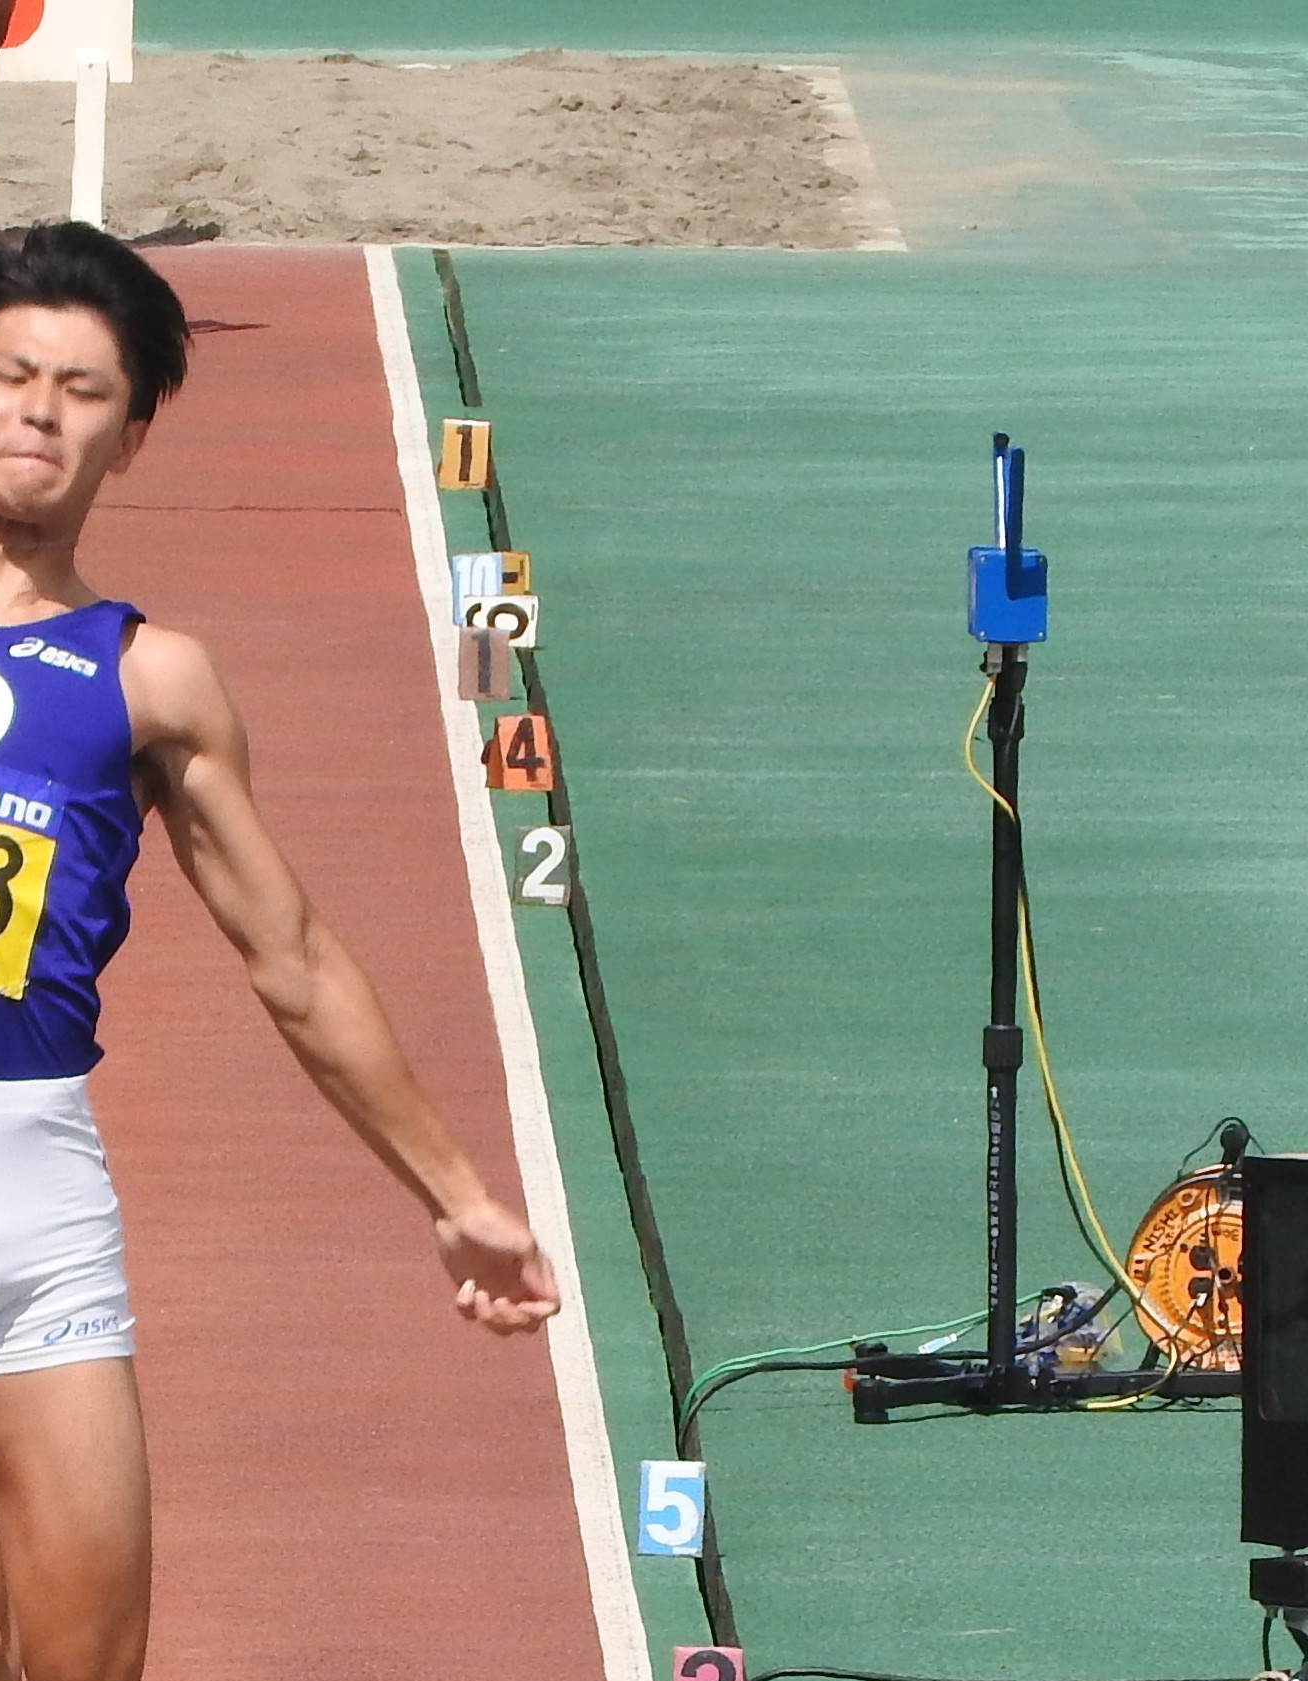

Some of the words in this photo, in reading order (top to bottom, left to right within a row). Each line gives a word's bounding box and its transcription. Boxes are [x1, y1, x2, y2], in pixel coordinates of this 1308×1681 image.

[455, 424, 473, 482] 1
[38, 645, 99, 678] asics
[472, 630, 491, 693] 1
[505, 717, 546, 783] 4
[521, 826, 567, 898] 2
[645, 1462, 700, 1547] 5
